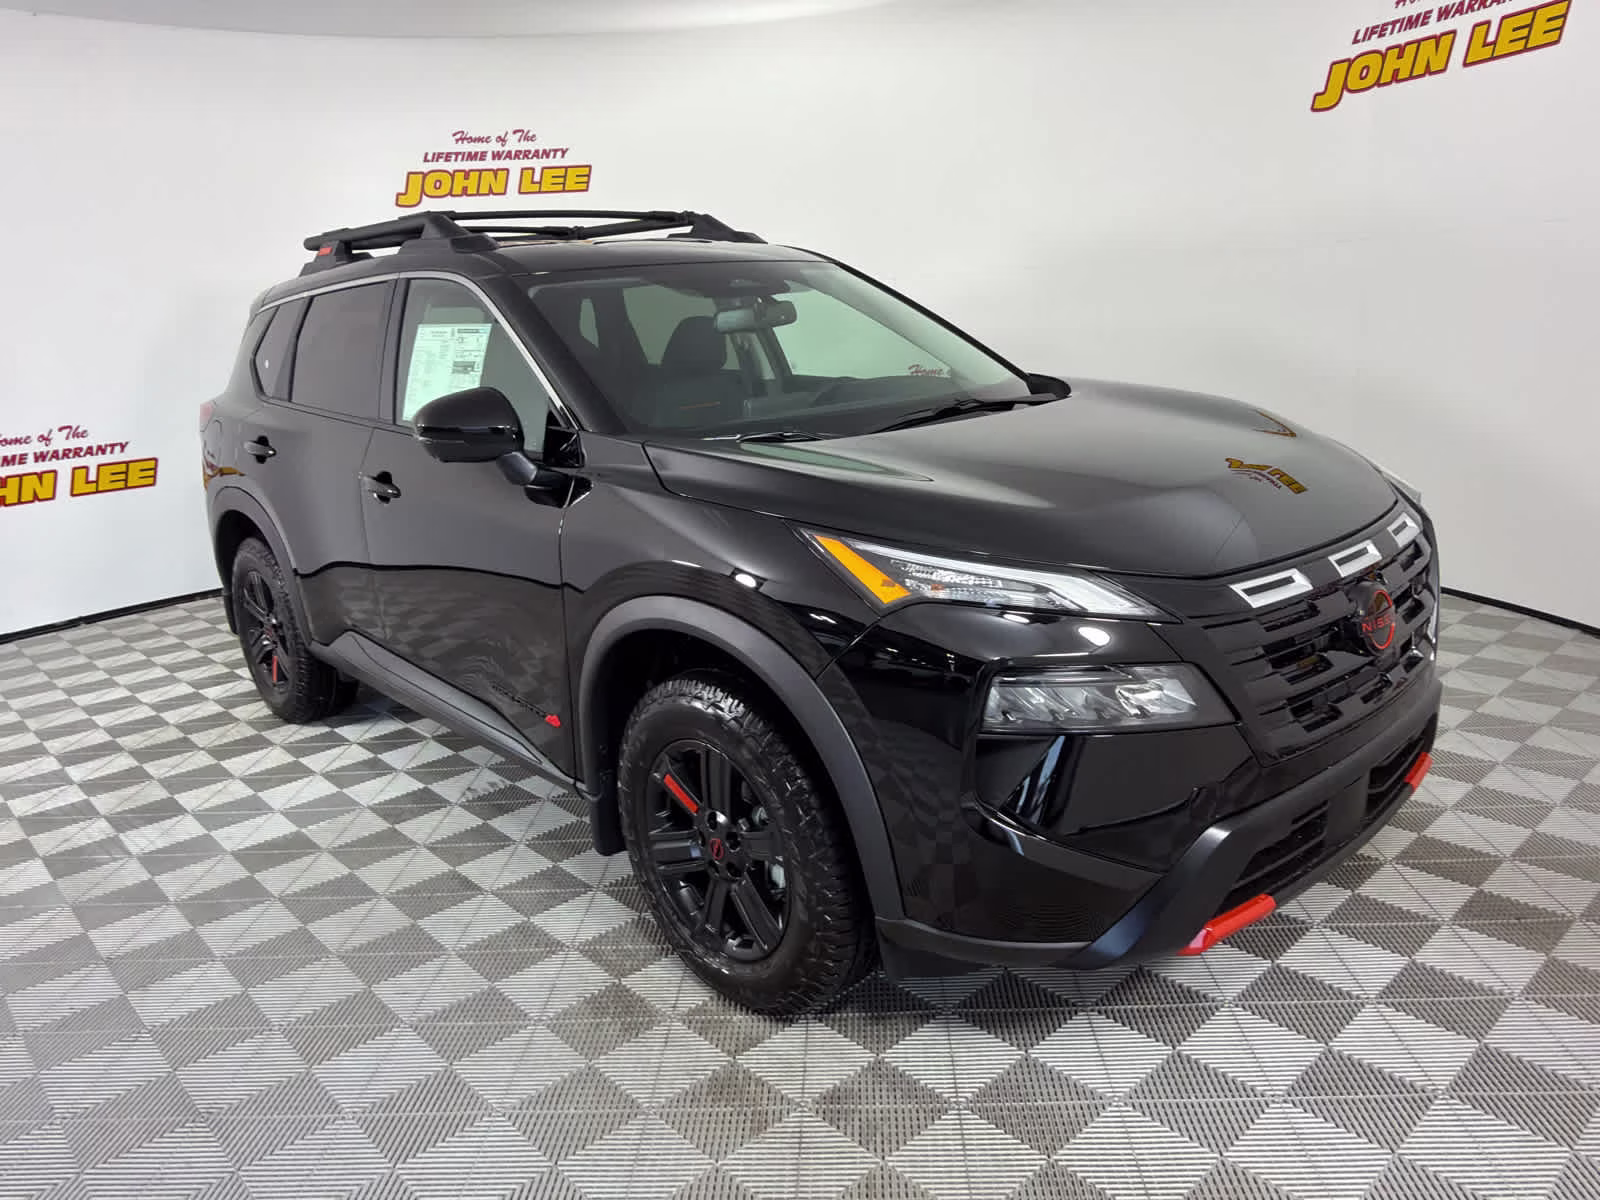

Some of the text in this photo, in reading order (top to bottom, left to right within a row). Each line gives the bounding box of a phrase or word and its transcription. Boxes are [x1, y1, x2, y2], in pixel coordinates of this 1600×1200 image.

[1351, 0, 1512, 45] LIFETIME WARR
[1311, 0, 1572, 113] JOHN LEE
[452, 129, 537, 147] Home of The
[422, 148, 569, 163] LIFETIME WARRANTY
[395, 165, 592, 208] JOHN LEE
[0, 425, 89, 447] ome of The
[33, 441, 129, 463] WARRANTY
[0, 457, 158, 507] HN LEE
